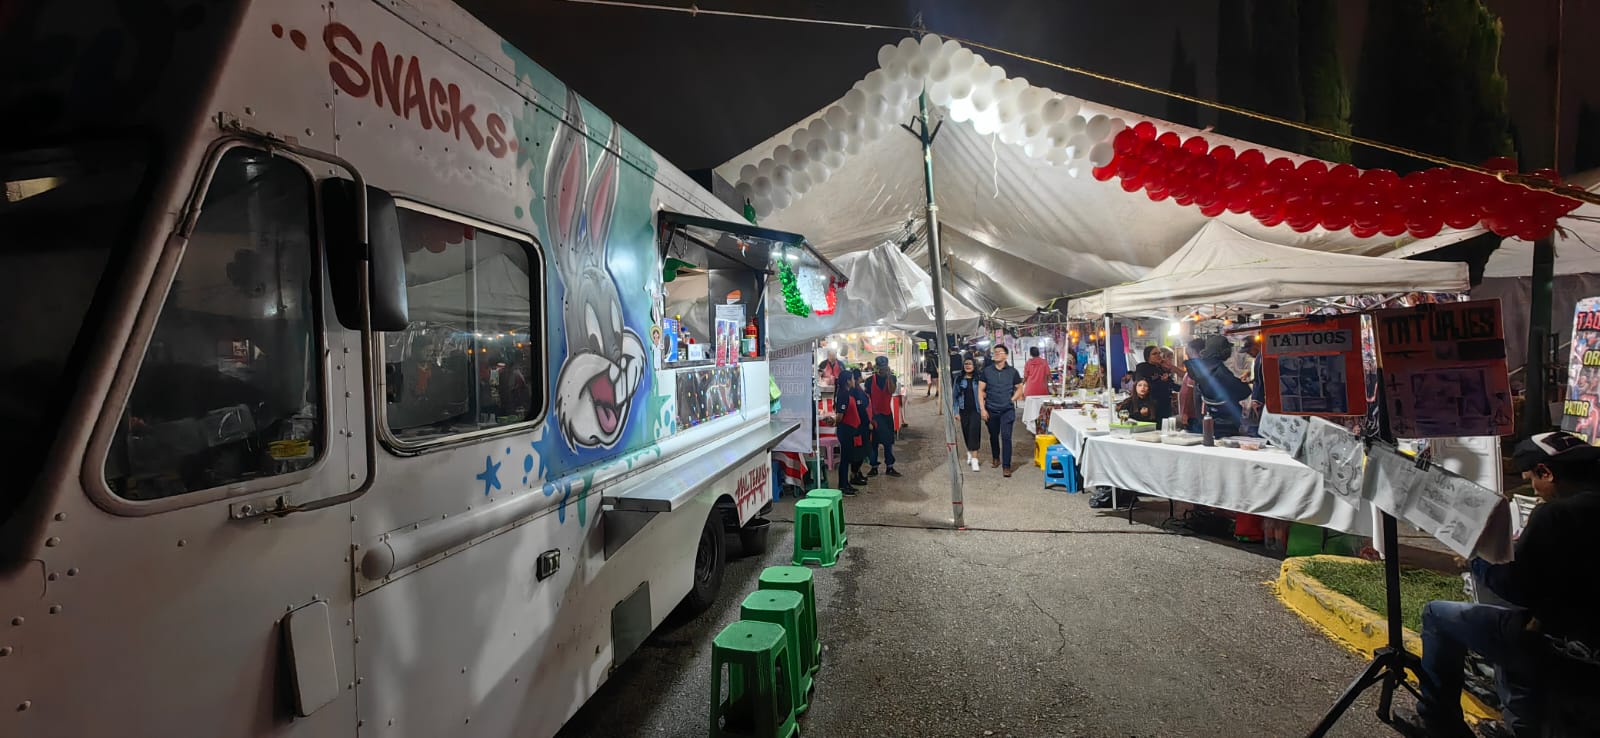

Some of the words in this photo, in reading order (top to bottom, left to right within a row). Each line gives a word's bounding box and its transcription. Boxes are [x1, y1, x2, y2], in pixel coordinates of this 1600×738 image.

[323, 22, 507, 158] SNACKS
[1269, 331, 1346, 347] TATTOOS
[1584, 350, 1600, 366] OR
